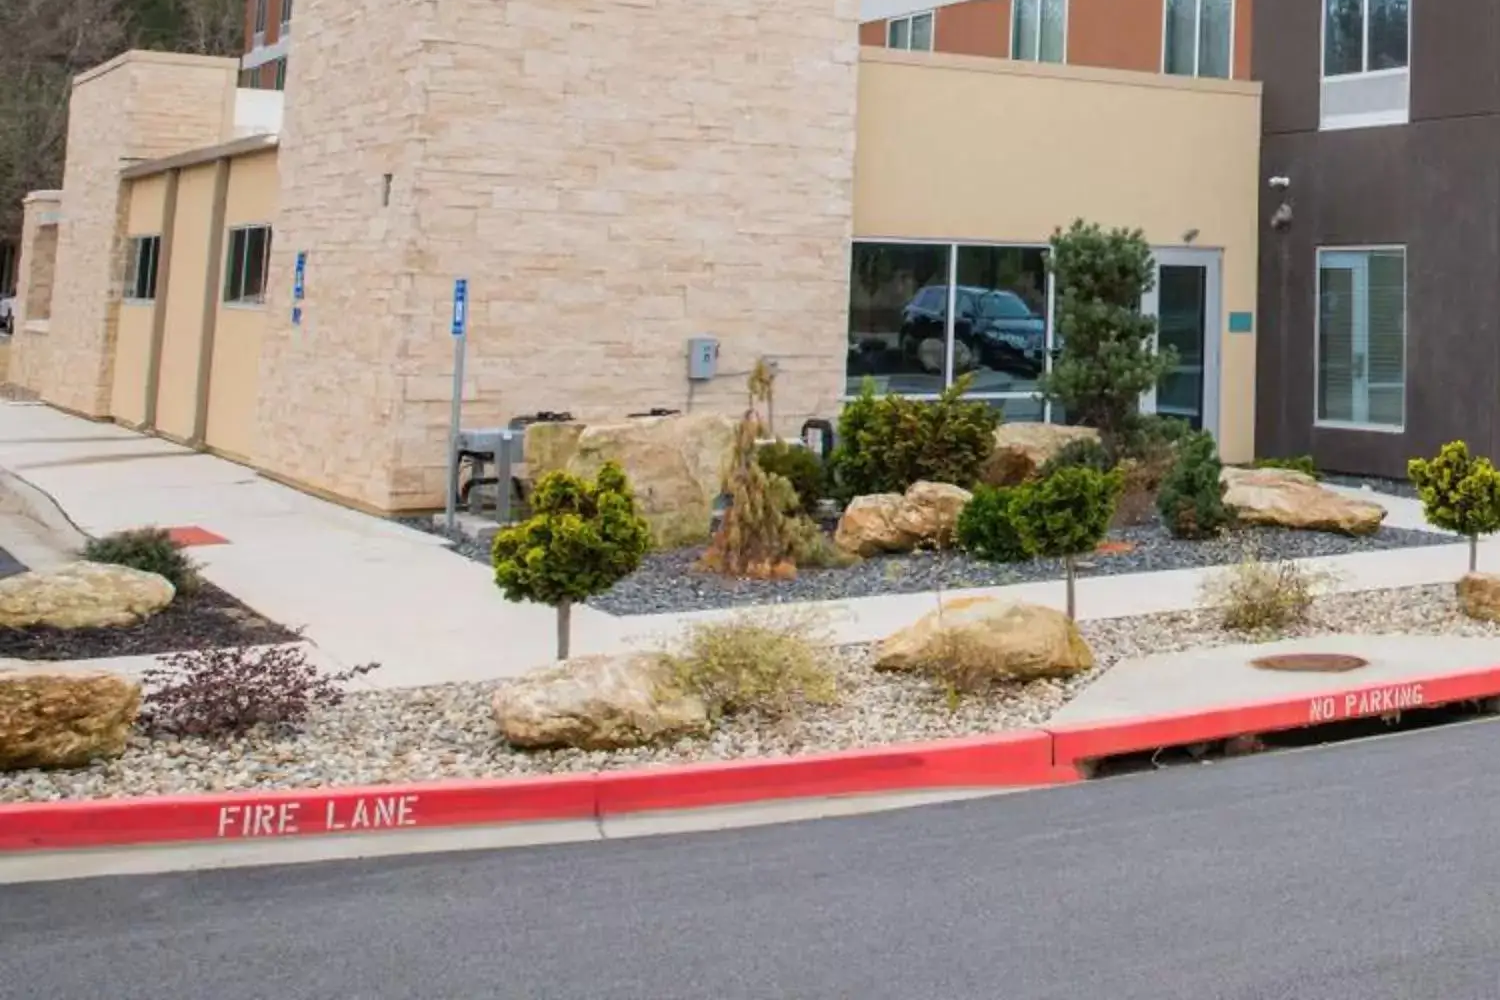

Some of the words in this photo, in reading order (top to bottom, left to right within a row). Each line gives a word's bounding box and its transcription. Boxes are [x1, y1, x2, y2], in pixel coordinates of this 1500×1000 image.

[1309, 697, 1336, 721] NO
[1345, 684, 1424, 716] PARKING
[217, 802, 300, 836] FIRE
[325, 796, 419, 830] LANE
